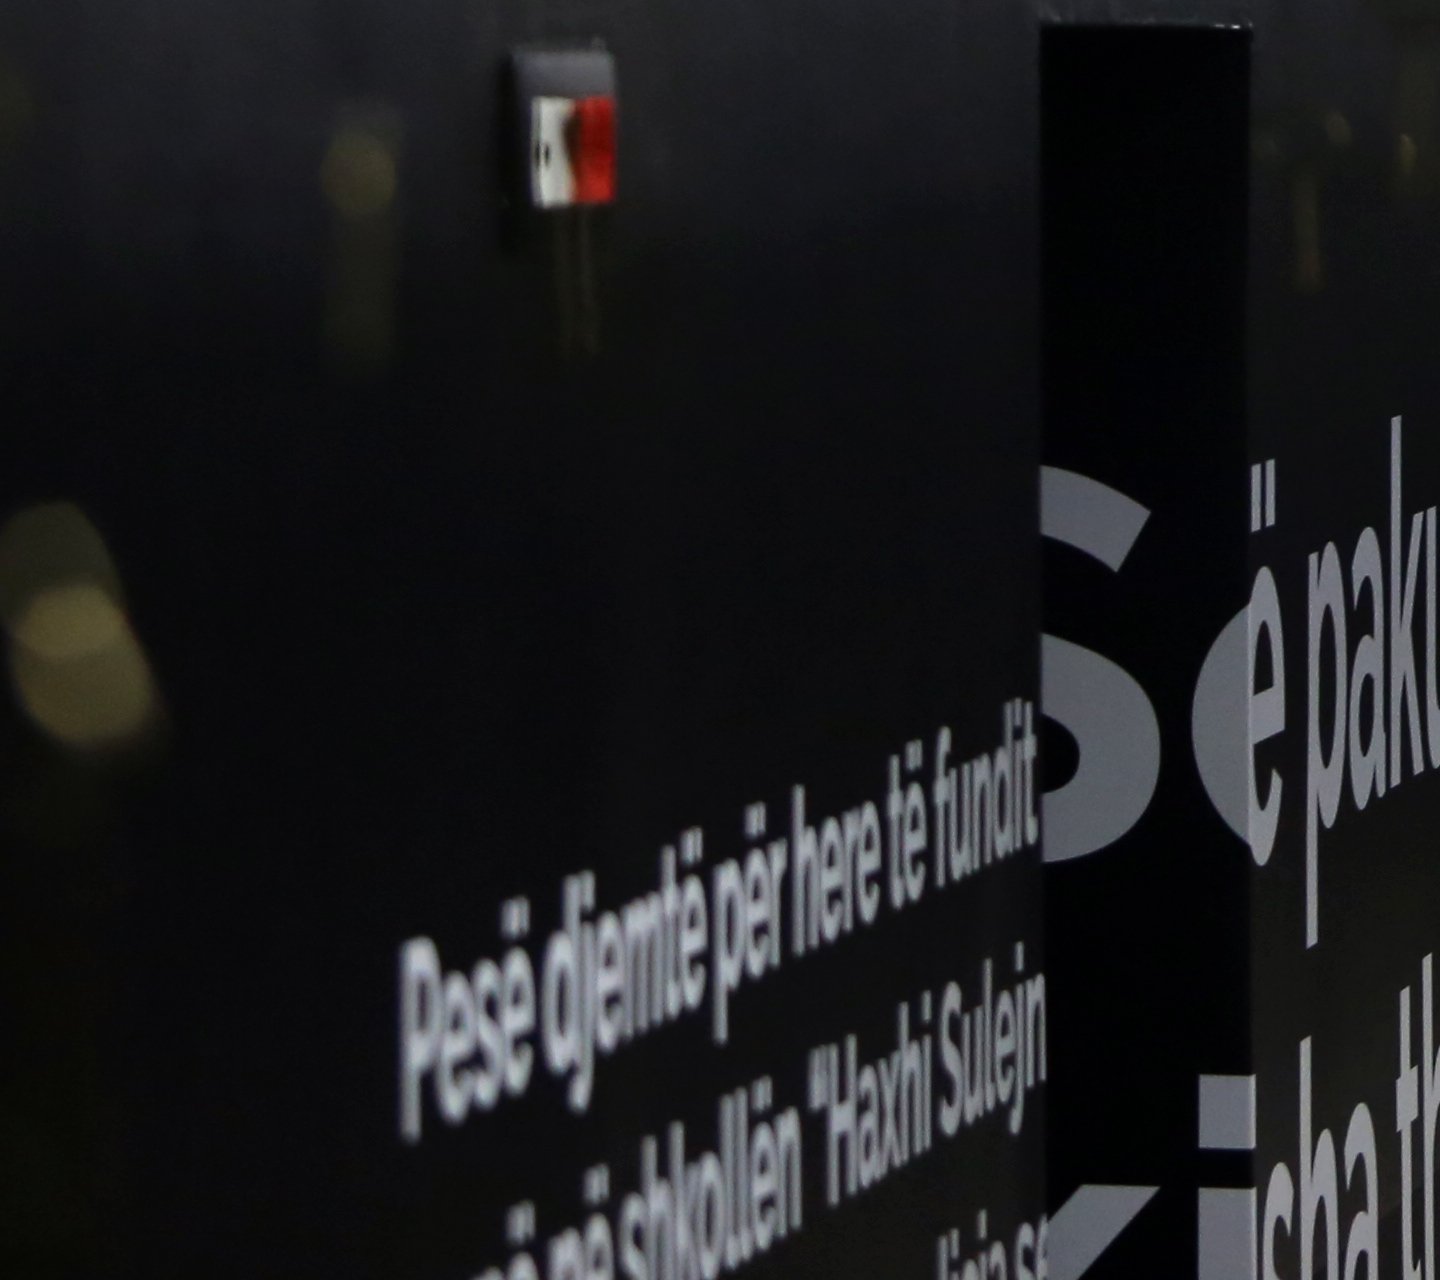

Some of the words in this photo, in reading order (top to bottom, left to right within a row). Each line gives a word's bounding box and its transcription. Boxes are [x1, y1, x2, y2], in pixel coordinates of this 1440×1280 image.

[399, 894, 537, 1144] Pesë
[541, 826, 708, 1116] djemtë
[712, 801, 788, 1045] për
[790, 782, 882, 957] here
[887, 738, 928, 910] të
[932, 696, 1039, 890] fundit
[617, 1074, 802, 1280] shkollën
[808, 989, 933, 1209] “Haxhi
[938, 941, 1047, 1135] Sulejn
